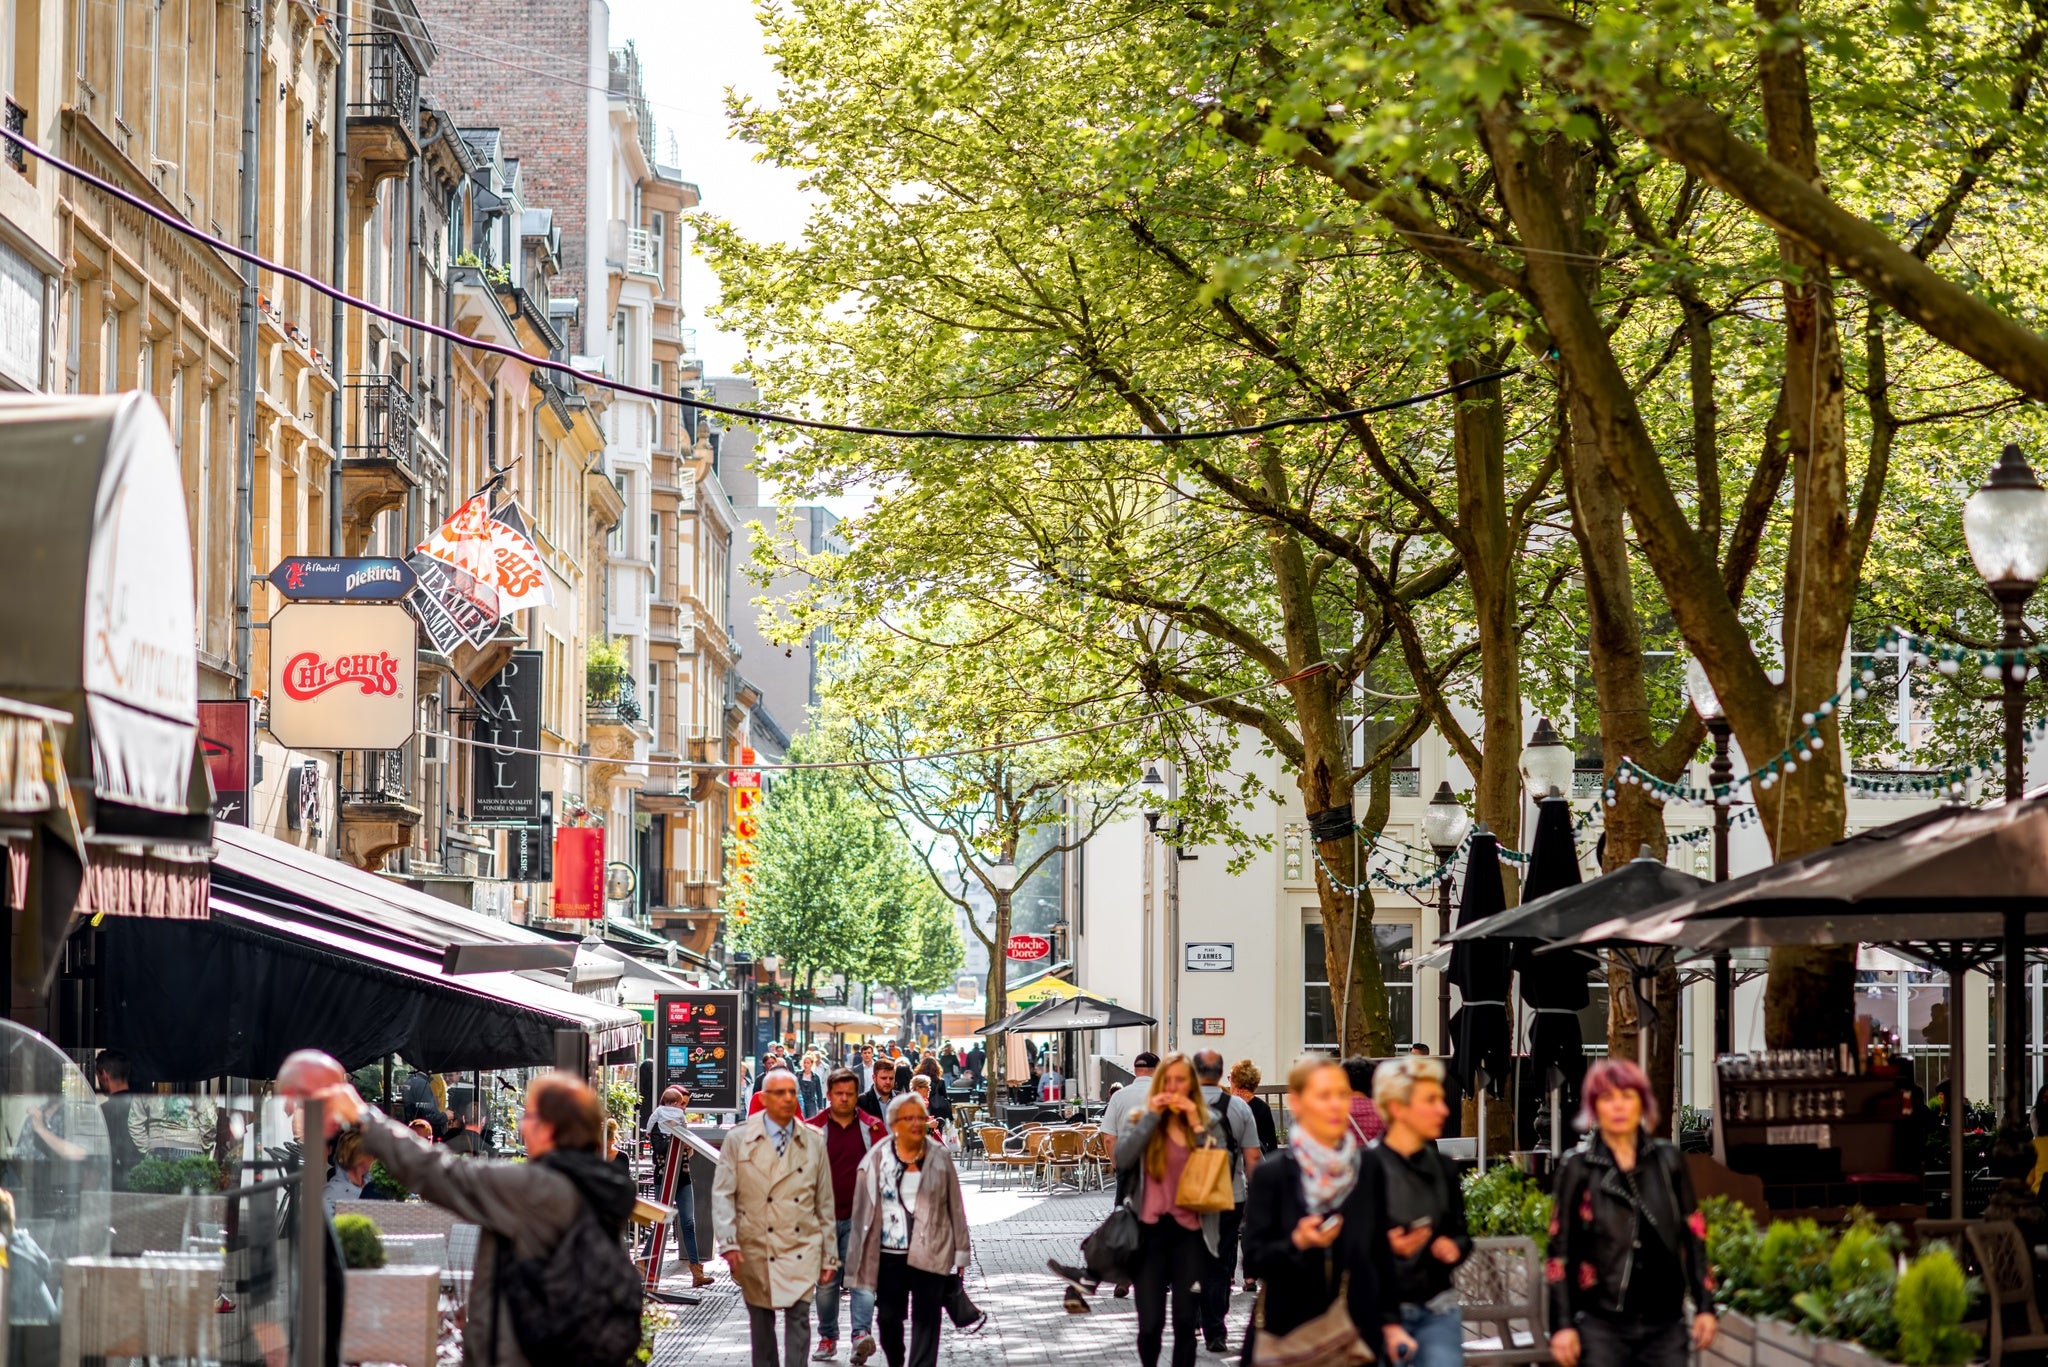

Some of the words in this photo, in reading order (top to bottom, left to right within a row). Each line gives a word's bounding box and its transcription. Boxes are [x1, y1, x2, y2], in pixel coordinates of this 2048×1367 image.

[346, 565, 402, 592] Diekirch
[443, 592, 491, 643] MEX
[282, 651, 399, 701] CHI-CHI'S
[491, 661, 523, 788] PAUL
[508, 799, 534, 807] QUALITÉ
[1008, 940, 1045, 952] Brioche
[1012, 949, 1039, 958] Dorée
